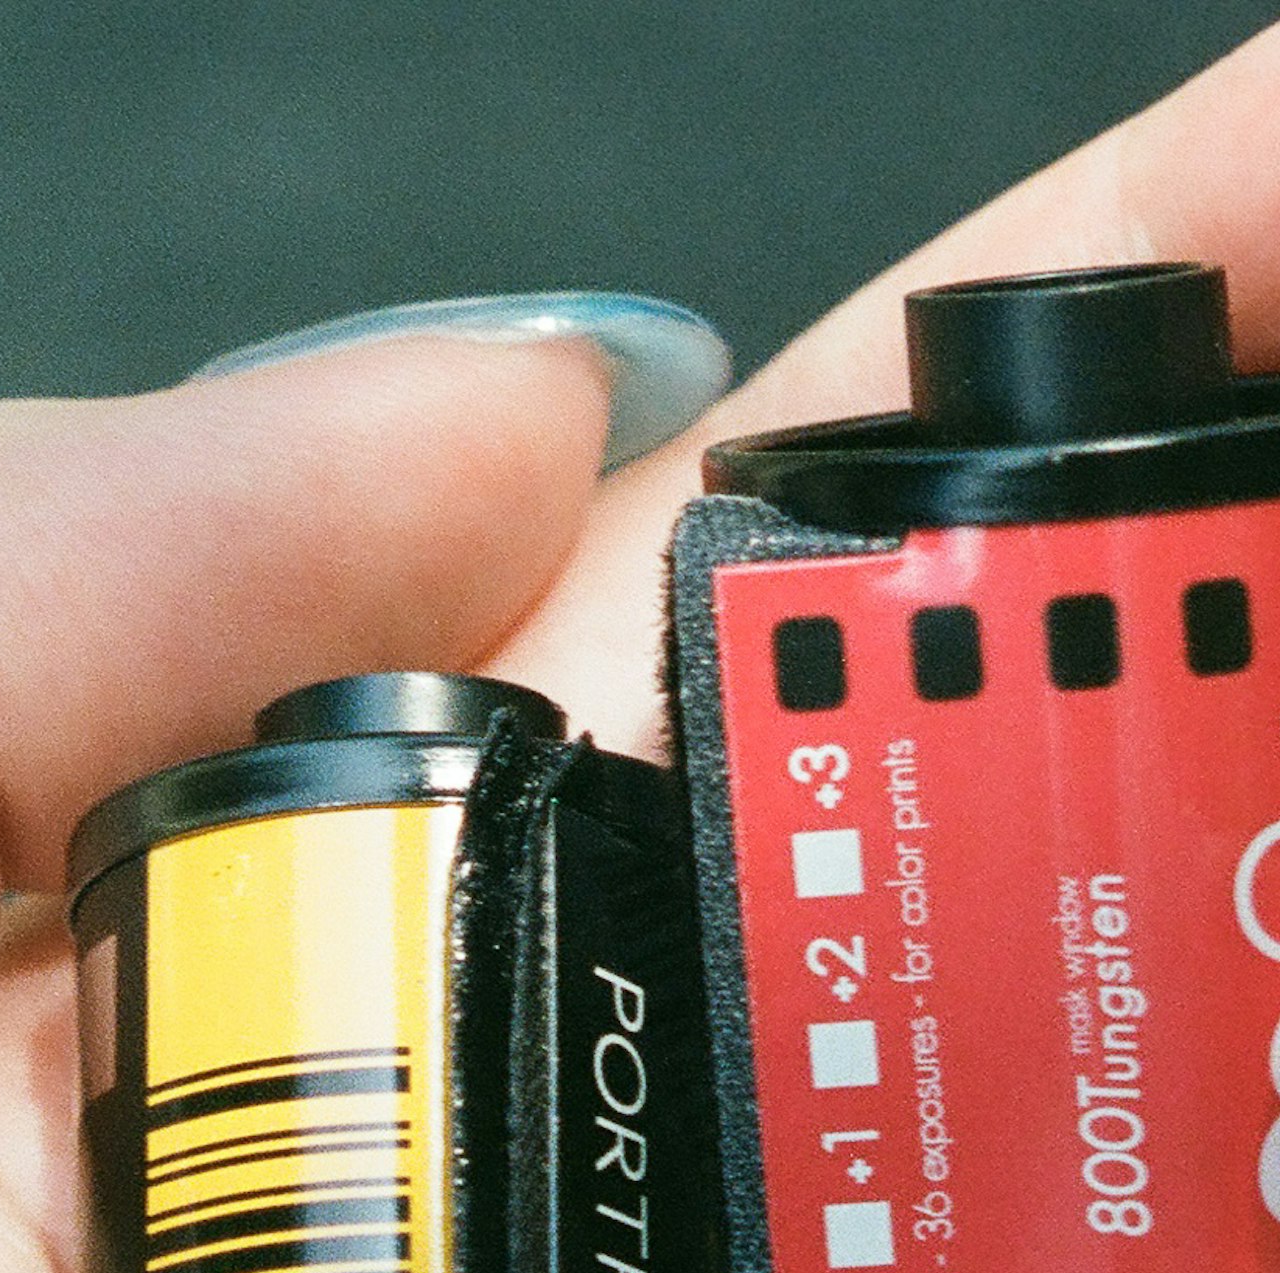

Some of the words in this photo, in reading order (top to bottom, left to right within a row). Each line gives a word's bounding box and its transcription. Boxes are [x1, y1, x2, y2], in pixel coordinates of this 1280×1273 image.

[787, 743, 851, 810] +3
[880, 738, 932, 831] prints
[883, 841, 930, 927] color
[889, 937, 934, 985] for
[1051, 875, 1088, 980] window
[804, 934, 867, 1003] +2
[1058, 985, 1092, 1055] mask
[909, 1014, 954, 1182] exposures
[821, 1129, 880, 1184] +1
[912, 1190, 955, 1242] 36
